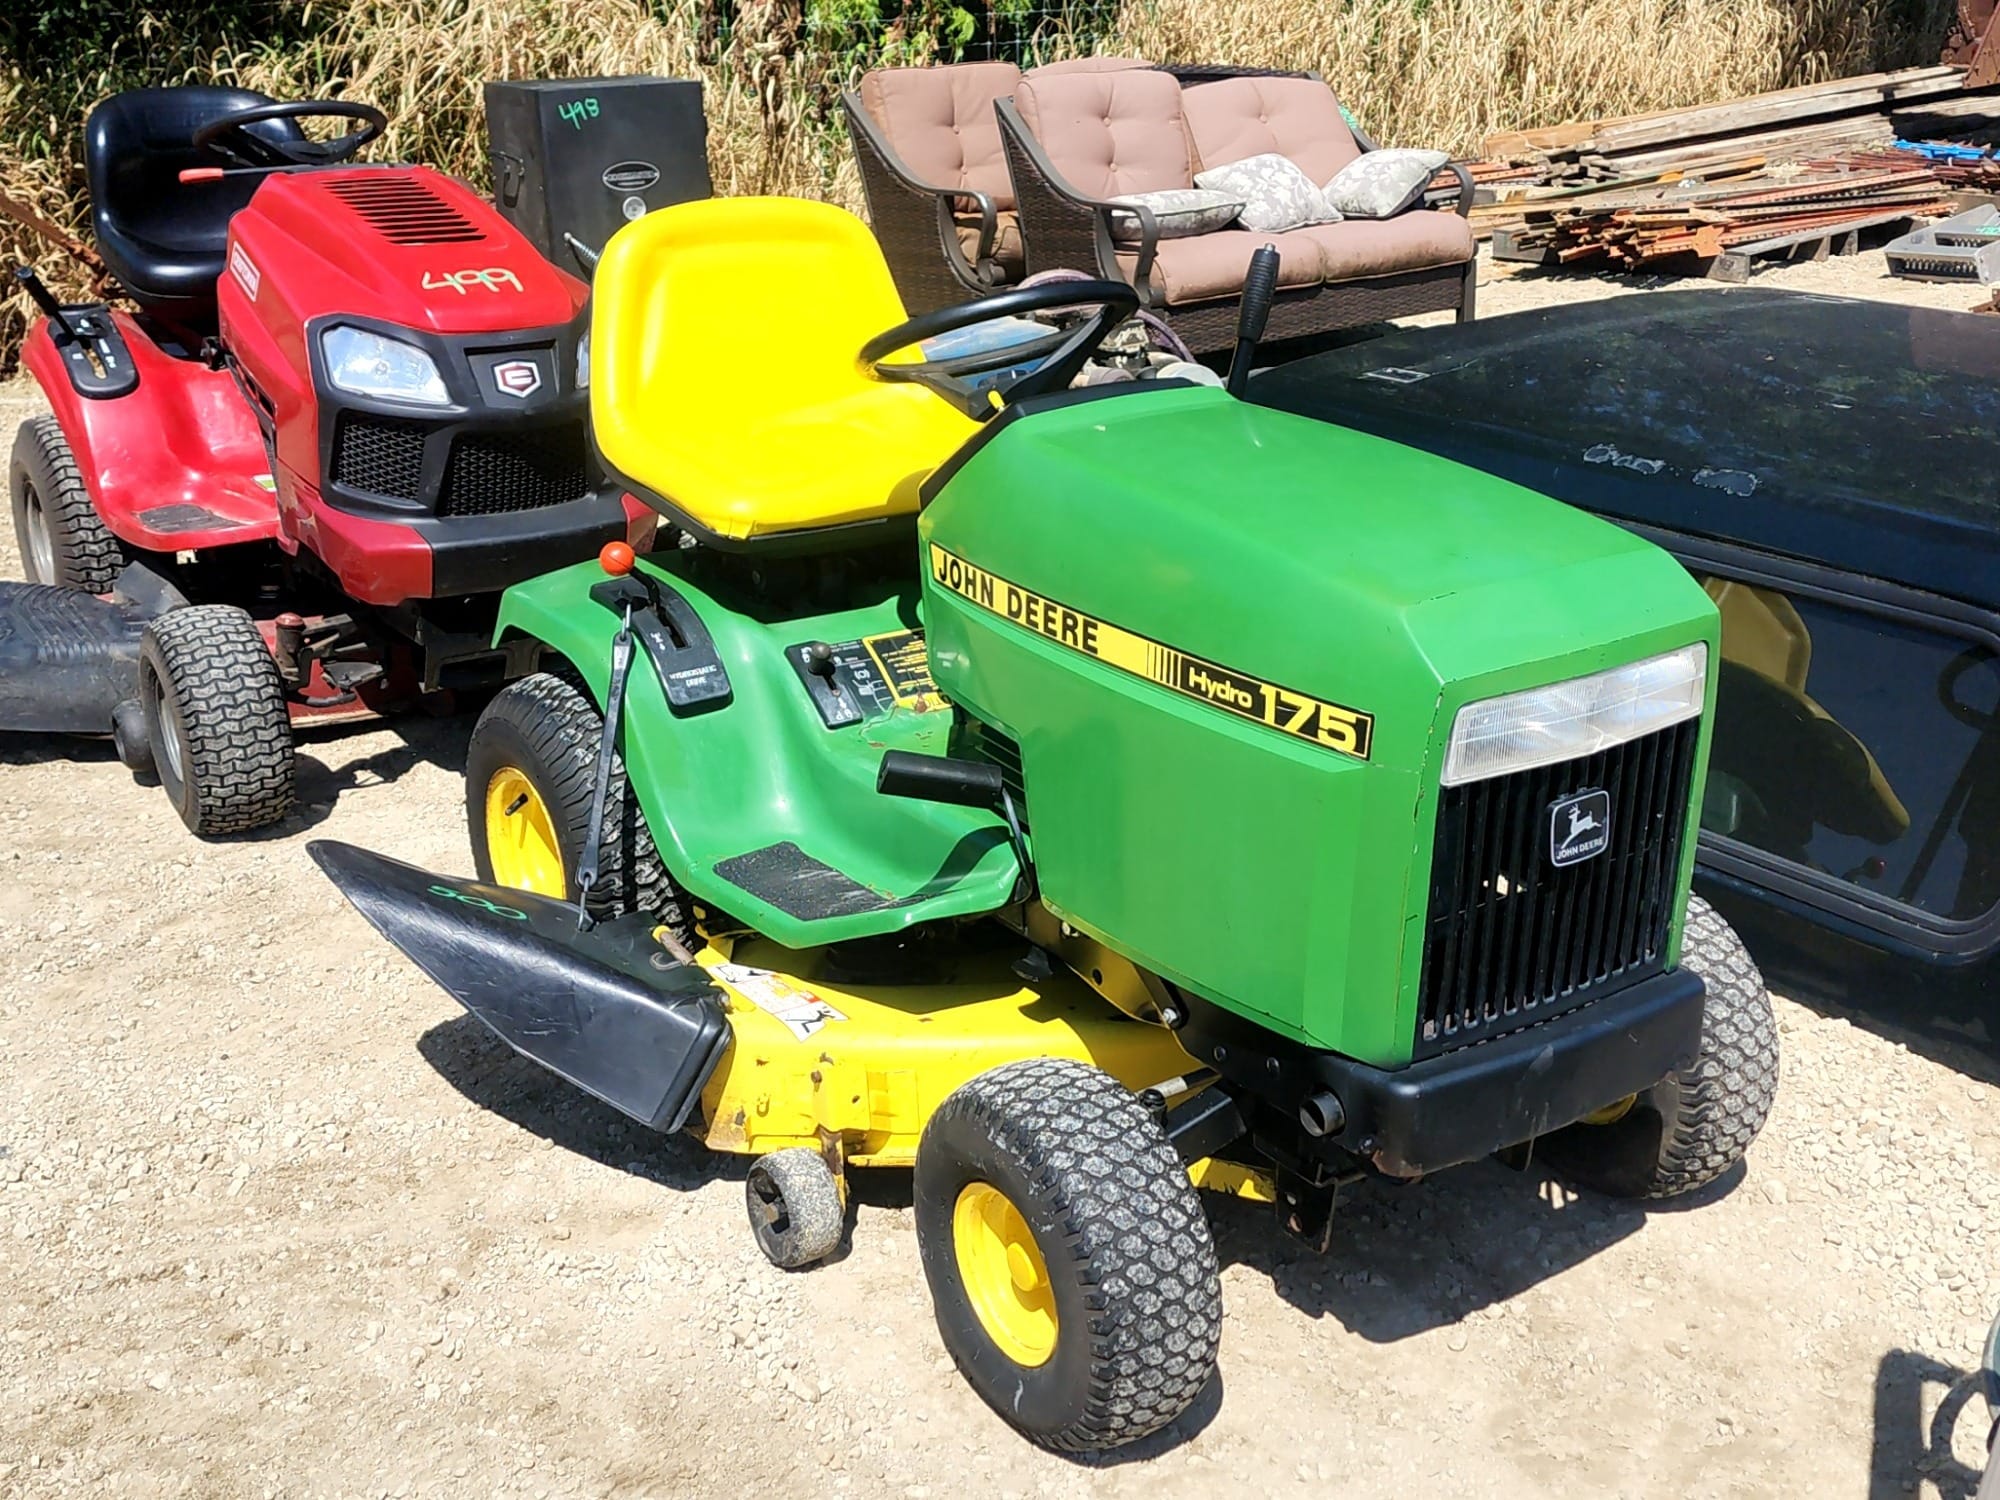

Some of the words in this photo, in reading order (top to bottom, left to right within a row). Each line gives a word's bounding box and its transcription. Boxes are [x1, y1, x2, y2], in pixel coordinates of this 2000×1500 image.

[558, 98, 600, 130] 498
[421, 267, 524, 295] 499
[938, 553, 994, 609] JOHN
[1007, 585, 1099, 656] DEERE
[1188, 666, 1253, 708] Hydro
[1259, 683, 1357, 752] 175
[1555, 845, 1579, 860] JOHN
[1579, 836, 1605, 853] DEERE
[427, 885, 528, 920] 500
